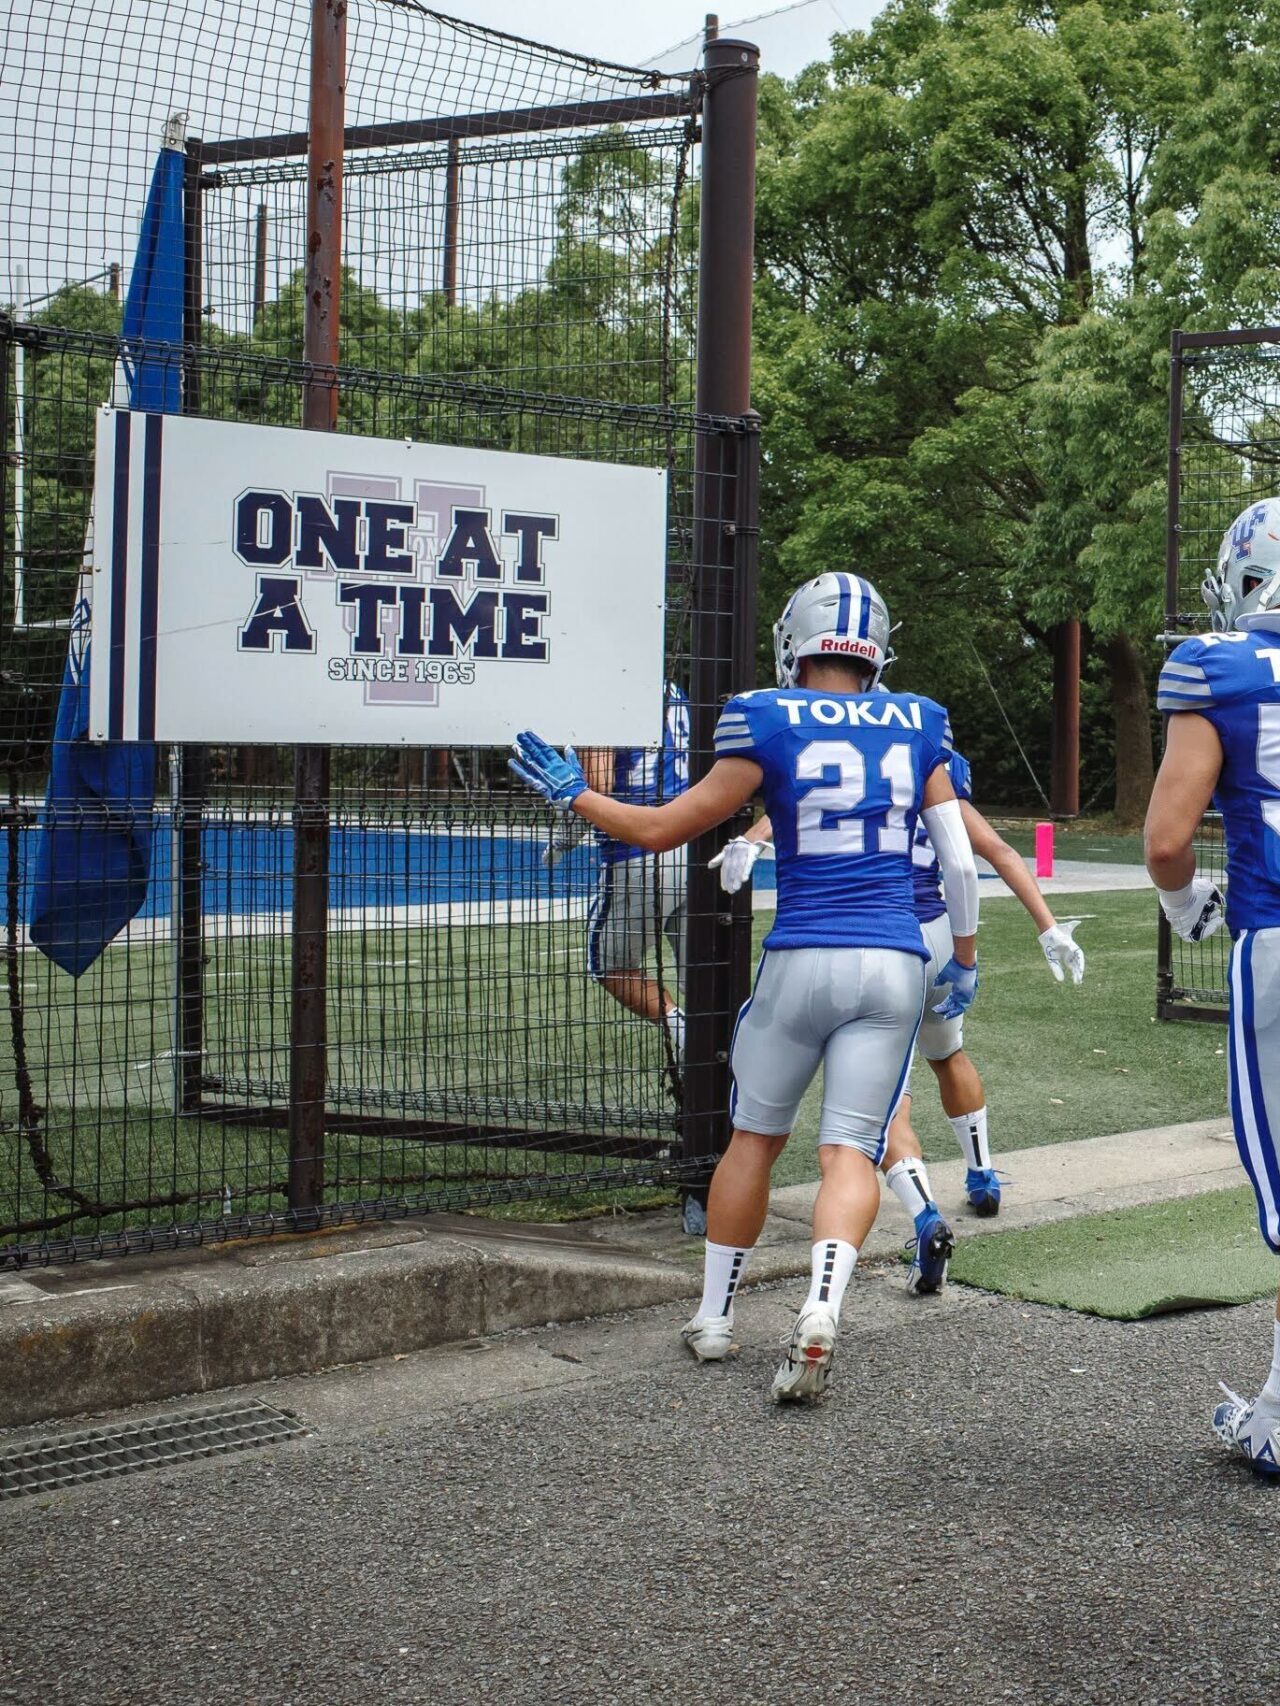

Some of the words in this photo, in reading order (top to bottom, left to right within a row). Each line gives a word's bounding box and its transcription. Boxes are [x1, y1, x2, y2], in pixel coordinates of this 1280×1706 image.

[232, 486, 418, 577] ONE
[436, 505, 560, 585] AT
[237, 573, 317, 654] A
[336, 578, 551, 664] TIME
[820, 638, 877, 659] Riddell
[328, 657, 410, 683] SINCE
[415, 660, 476, 685] 1965
[776, 697, 923, 731] TOKAI
[796, 740, 916, 856] 21
